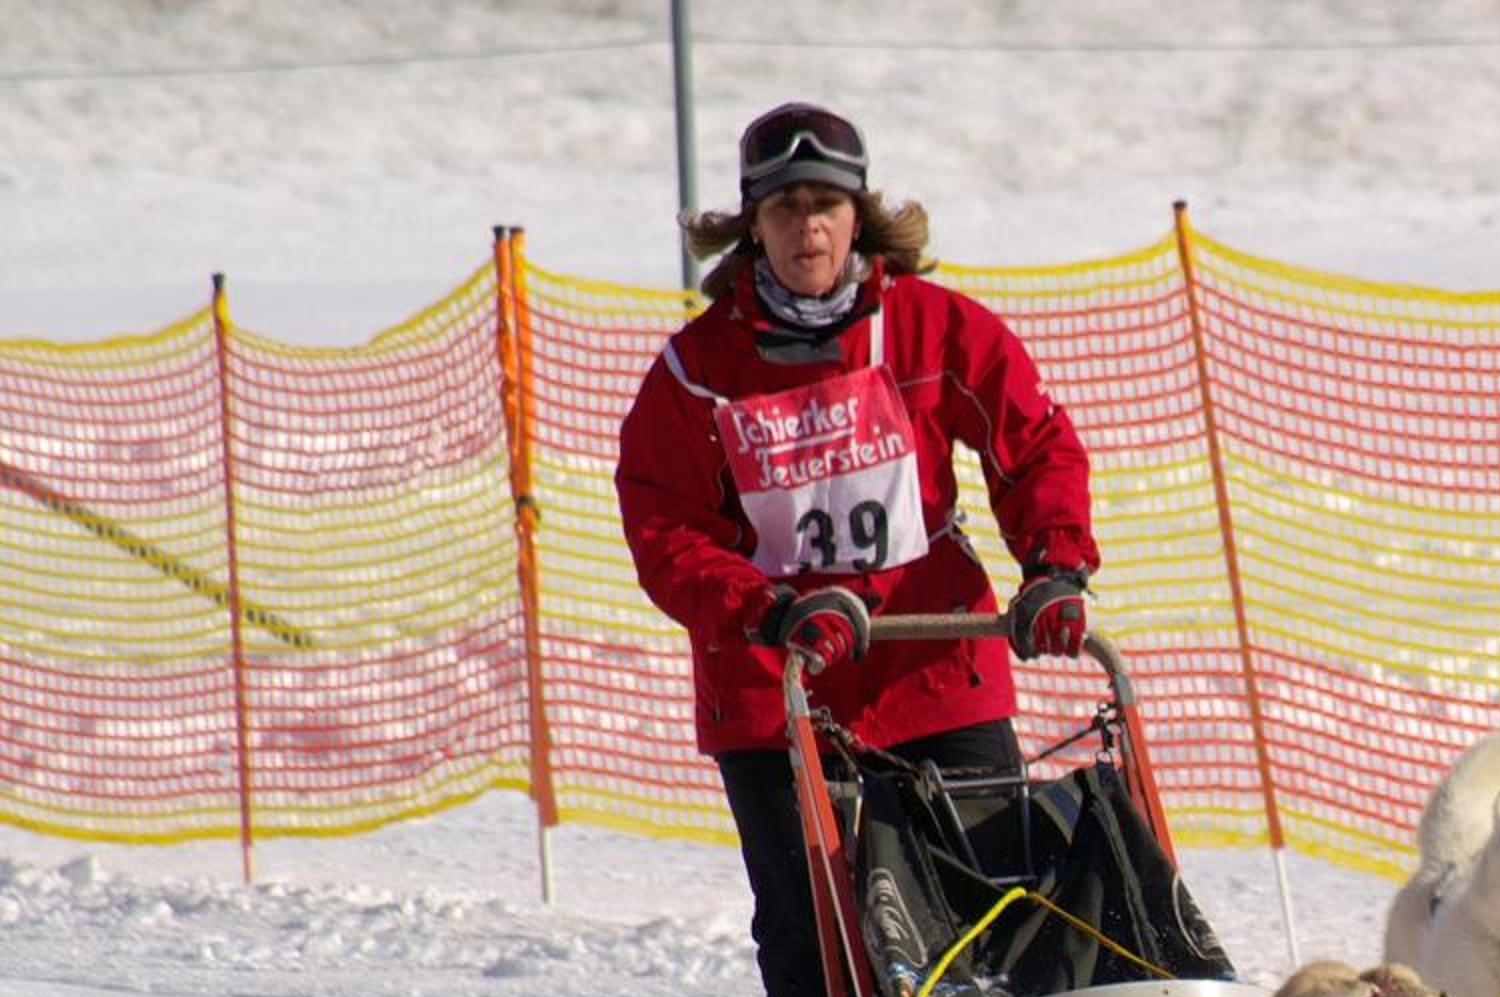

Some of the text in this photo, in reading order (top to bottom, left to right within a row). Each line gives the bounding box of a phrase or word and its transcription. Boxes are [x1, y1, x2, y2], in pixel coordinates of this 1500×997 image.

[732, 397, 858, 453] Schierker
[756, 425, 905, 487] Feuerstein
[796, 500, 888, 573] 39
